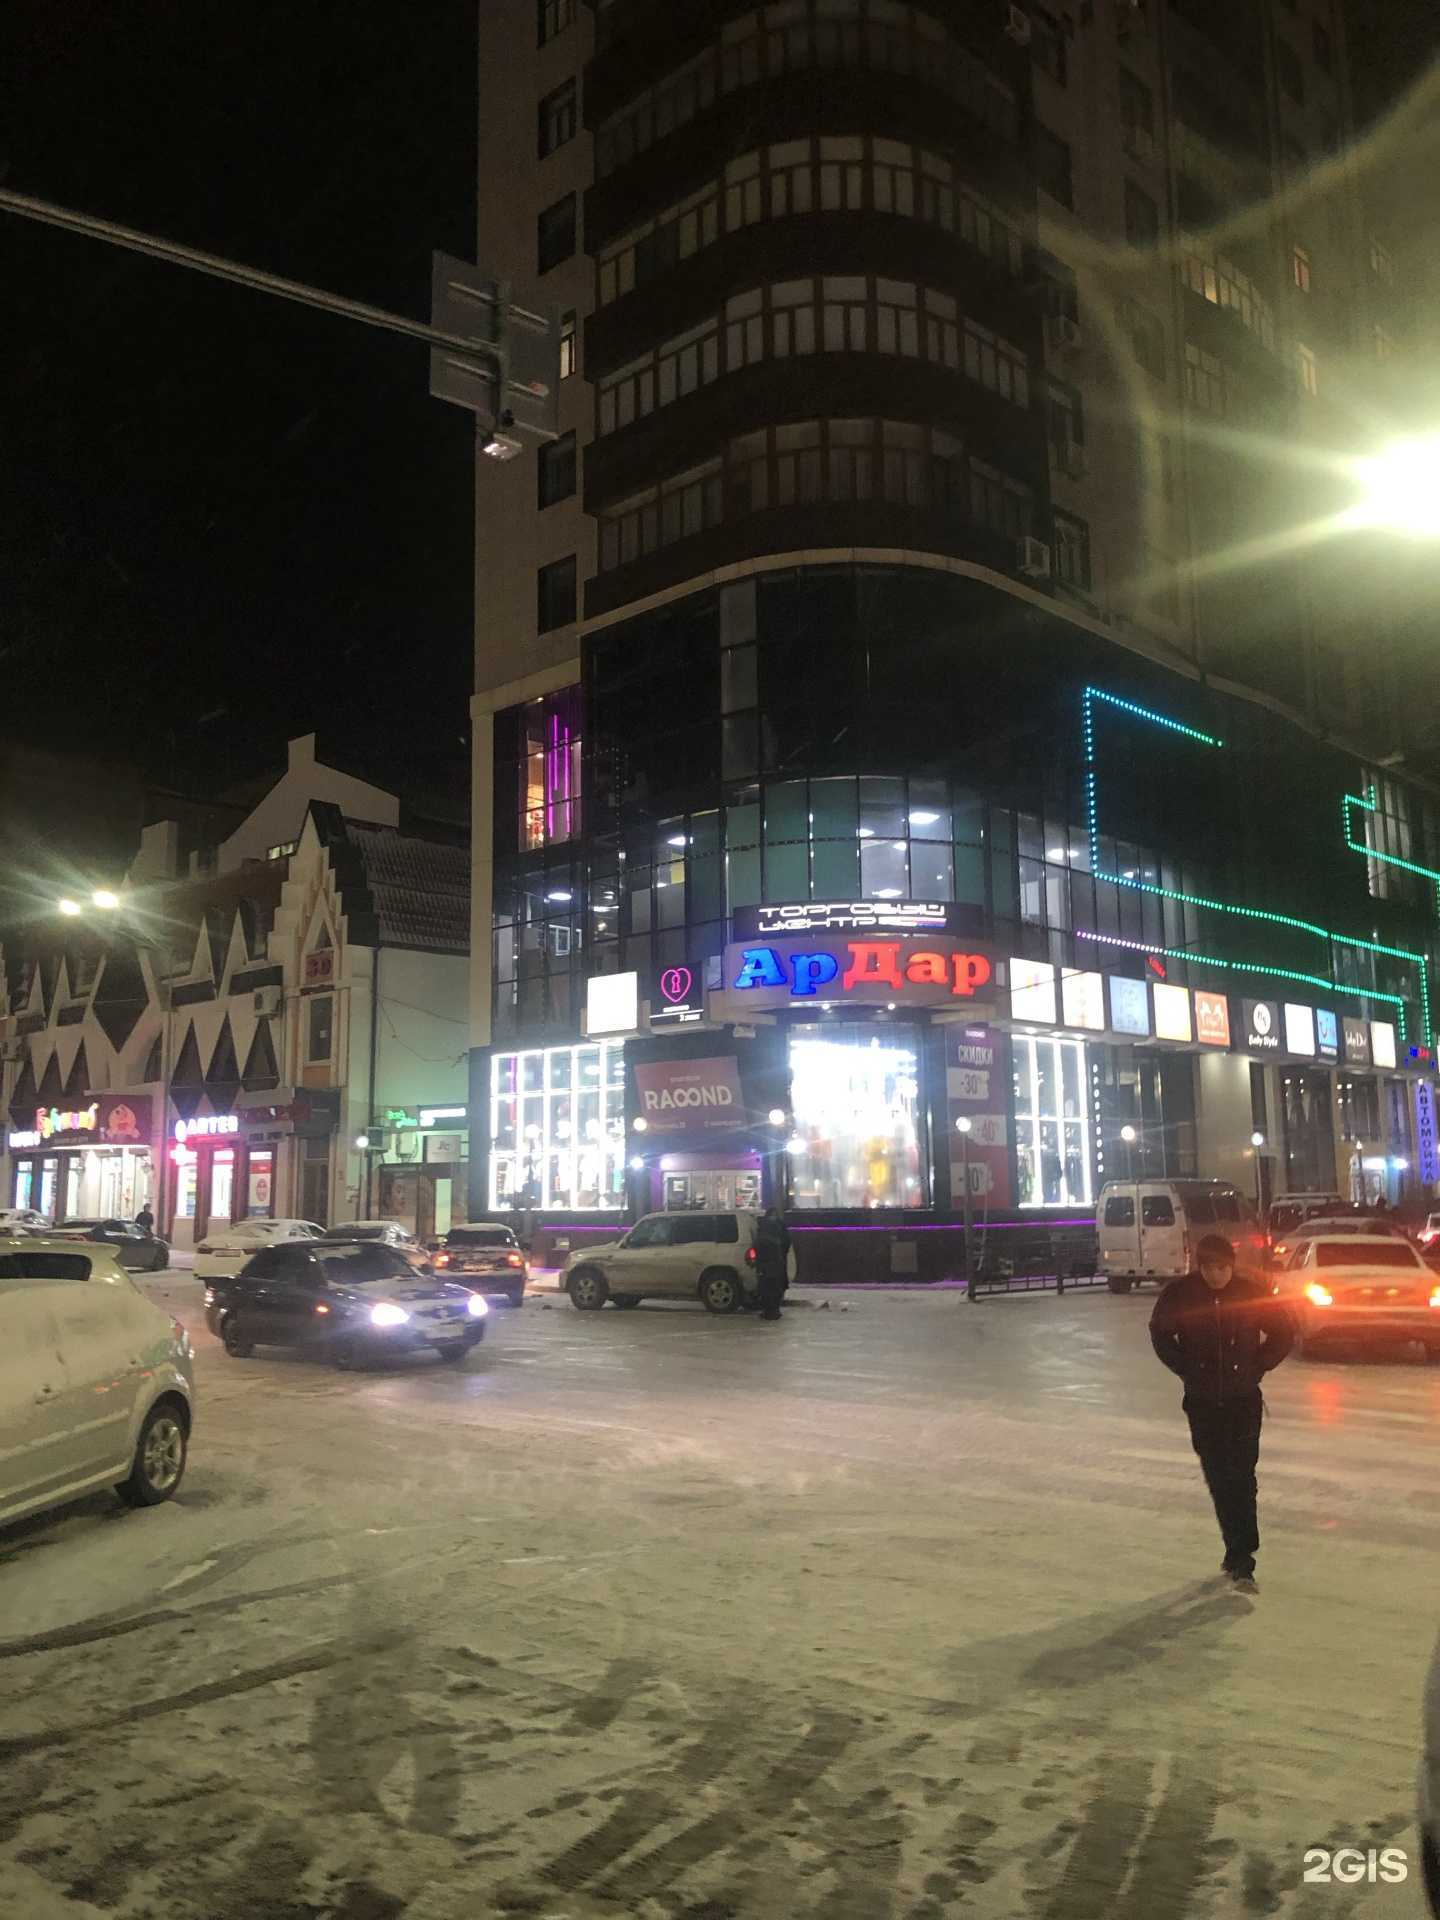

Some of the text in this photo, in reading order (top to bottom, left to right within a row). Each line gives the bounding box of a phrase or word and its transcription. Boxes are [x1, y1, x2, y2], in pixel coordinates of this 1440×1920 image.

[758, 903, 945, 918] ТОРГОВЫЙ
[734, 942, 992, 996] АрДар
[958, 1045, 993, 1066] СКИДКИ
